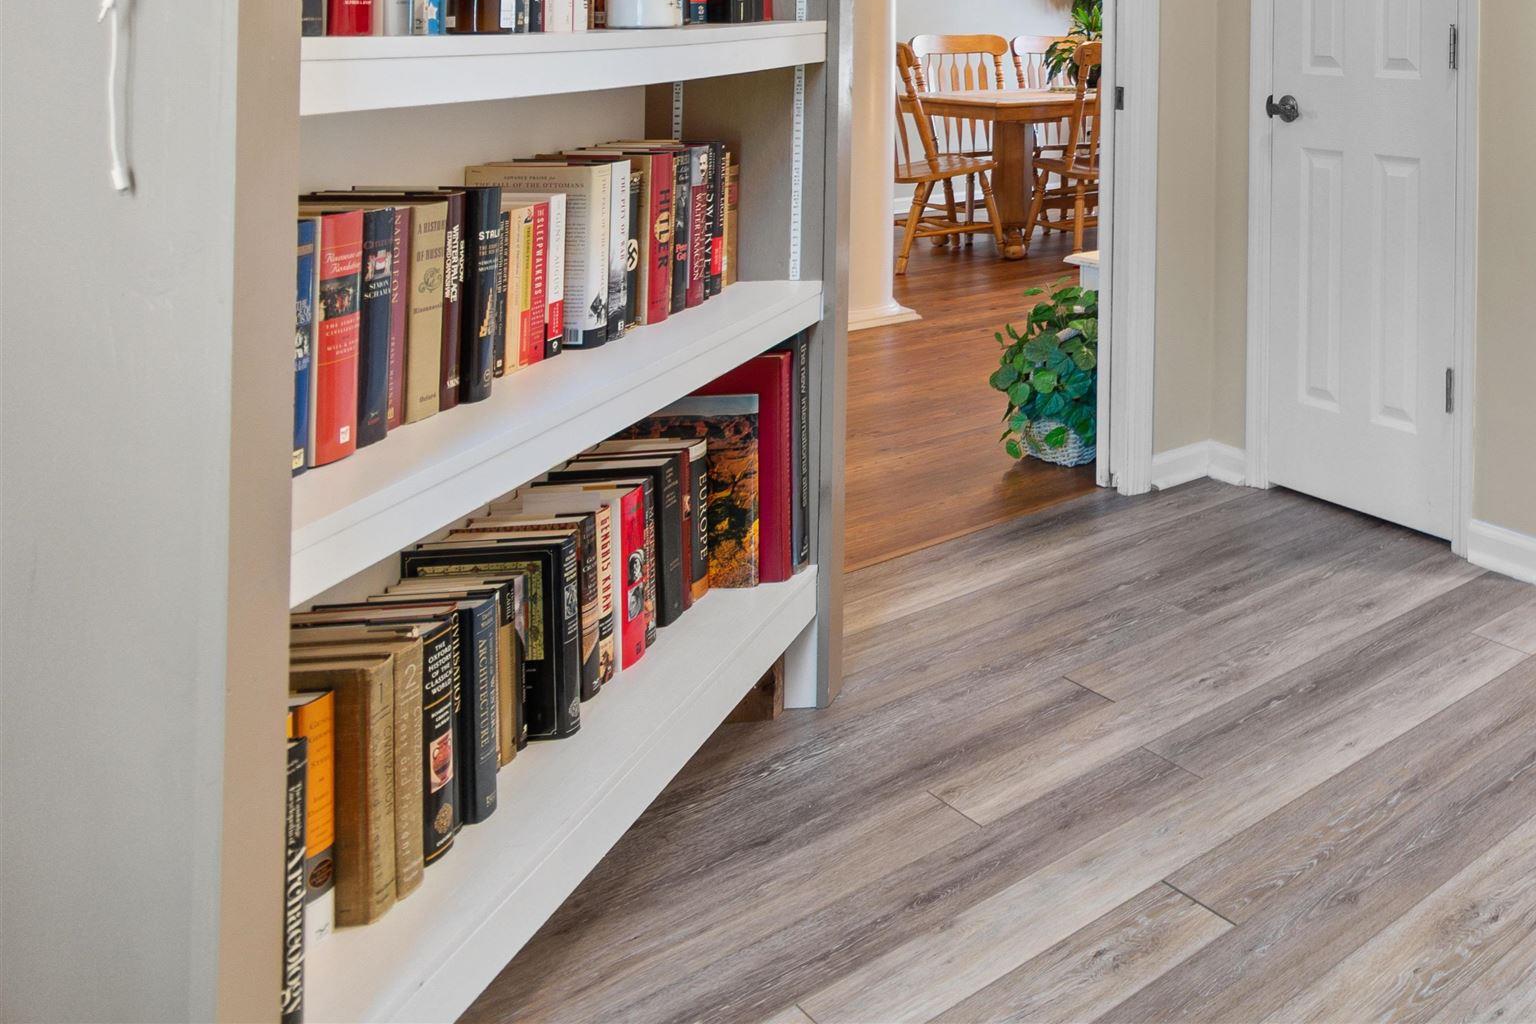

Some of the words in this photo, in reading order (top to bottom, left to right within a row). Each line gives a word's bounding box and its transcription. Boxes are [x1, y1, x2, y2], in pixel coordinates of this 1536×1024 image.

[451, 224, 460, 263] WINTER
[479, 228, 500, 241] STALI
[658, 189, 671, 269] HITLER
[704, 193, 715, 267] SWERVE
[391, 215, 401, 303] NAPOLEON
[416, 251, 424, 262] OF
[425, 247, 444, 260] RUSSI
[535, 218, 544, 296] SLEEPWALKERS
[692, 233, 700, 280] ISAACSON
[369, 279, 389, 290] SIMON
[450, 264, 458, 303] PALACE
[699, 472, 707, 560] EUROPE
[600, 517, 611, 572] GENGHIS
[602, 575, 612, 612] KHAN
[428, 644, 452, 663] OXFORD
[428, 653, 452, 672] HISTORY
[435, 641, 446, 651] THE
[451, 612, 461, 713] CIVILISATION
[404, 663, 417, 690] 2
[431, 670, 439, 678] OF
[441, 663, 451, 672] THE
[431, 678, 452, 695] WORLD
[478, 639, 489, 747] ARCHITECTURE
[383, 725, 394, 817] CIVILIZATION
[414, 706, 423, 795] CIVILIZATION
[281, 846, 306, 1014] Archaeology
